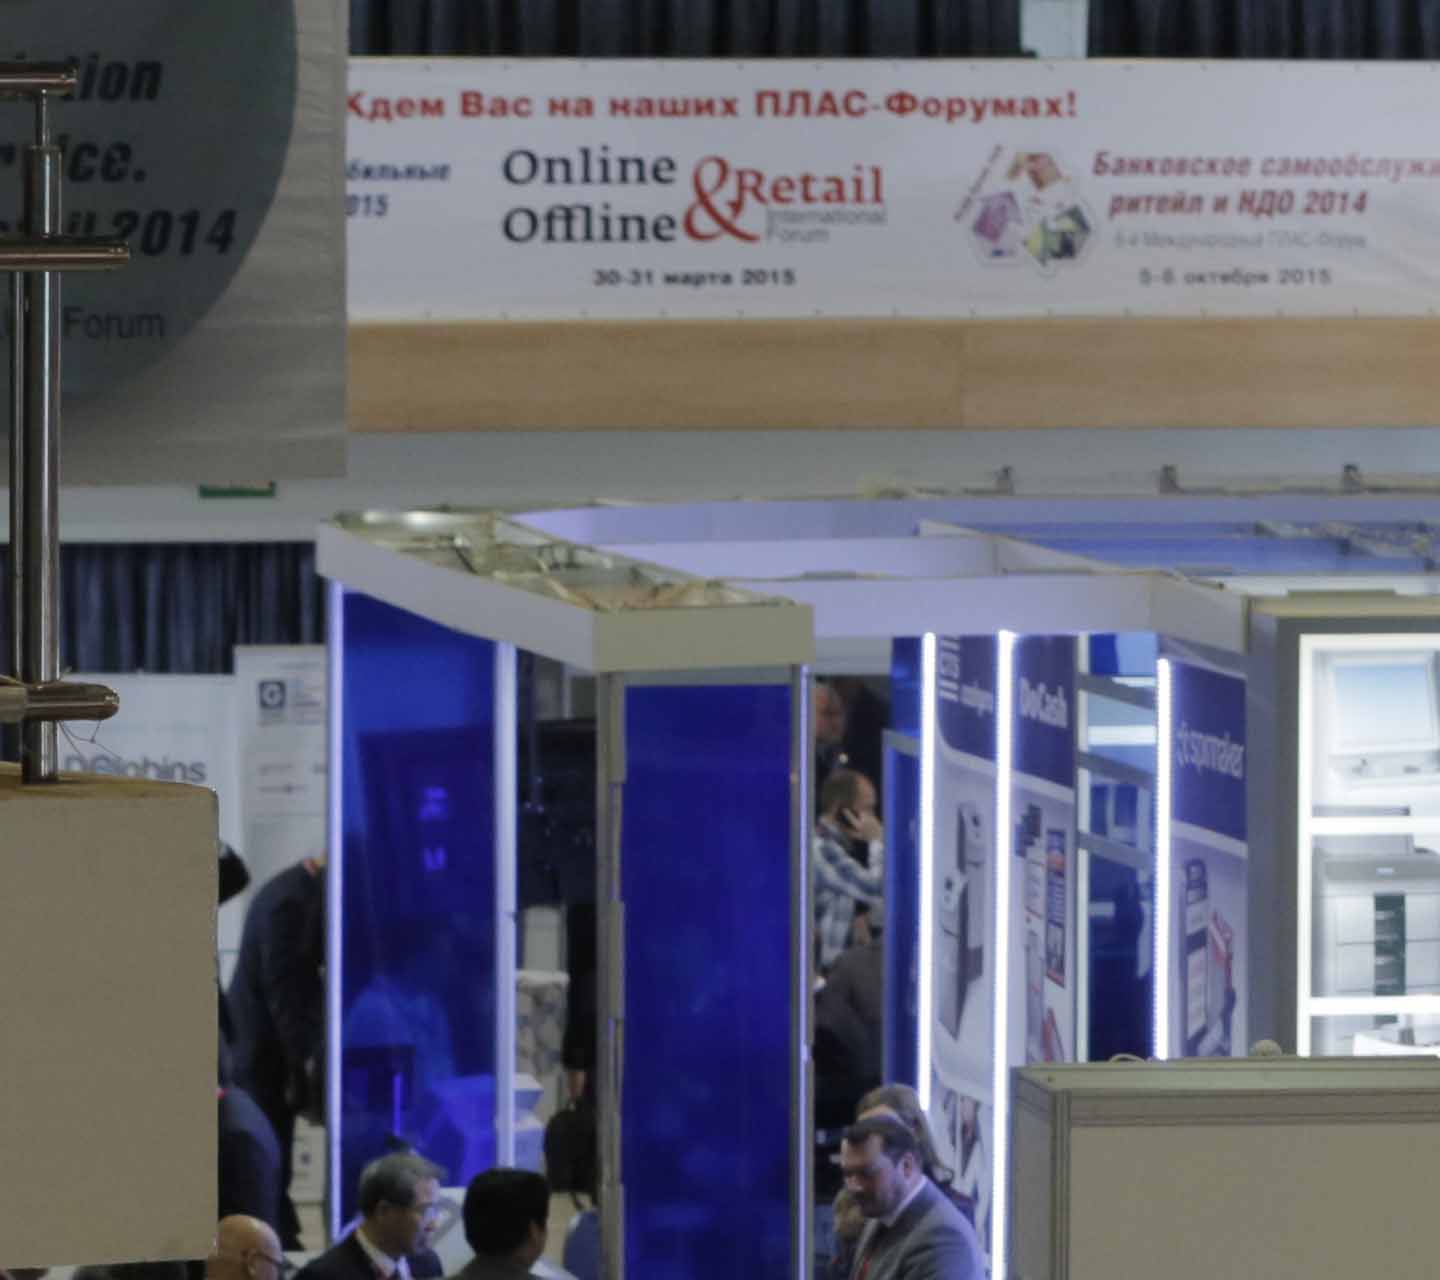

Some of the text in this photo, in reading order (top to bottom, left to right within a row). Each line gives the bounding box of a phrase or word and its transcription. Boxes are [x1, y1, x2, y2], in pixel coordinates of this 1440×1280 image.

[460, 89, 533, 118] Вас
[548, 94, 595, 118] на
[609, 94, 739, 119] наших
[754, 88, 1079, 124] ПЛАС-Форумах!
[503, 146, 676, 186] Online
[1092, 150, 1251, 177] Банковское
[347, 194, 389, 216] 015
[683, 156, 763, 243] &
[733, 166, 885, 206] Retail
[1108, 189, 1205, 219] ритейл
[1235, 189, 1296, 219] НДО
[1302, 190, 1368, 214] 2014
[503, 205, 677, 243] Offline
[593, 269, 796, 289] 30-31 марта 2015
[1183, 267, 1270, 286] октября
[1278, 267, 1333, 285] 2015
[63, 311, 166, 341] Forum
